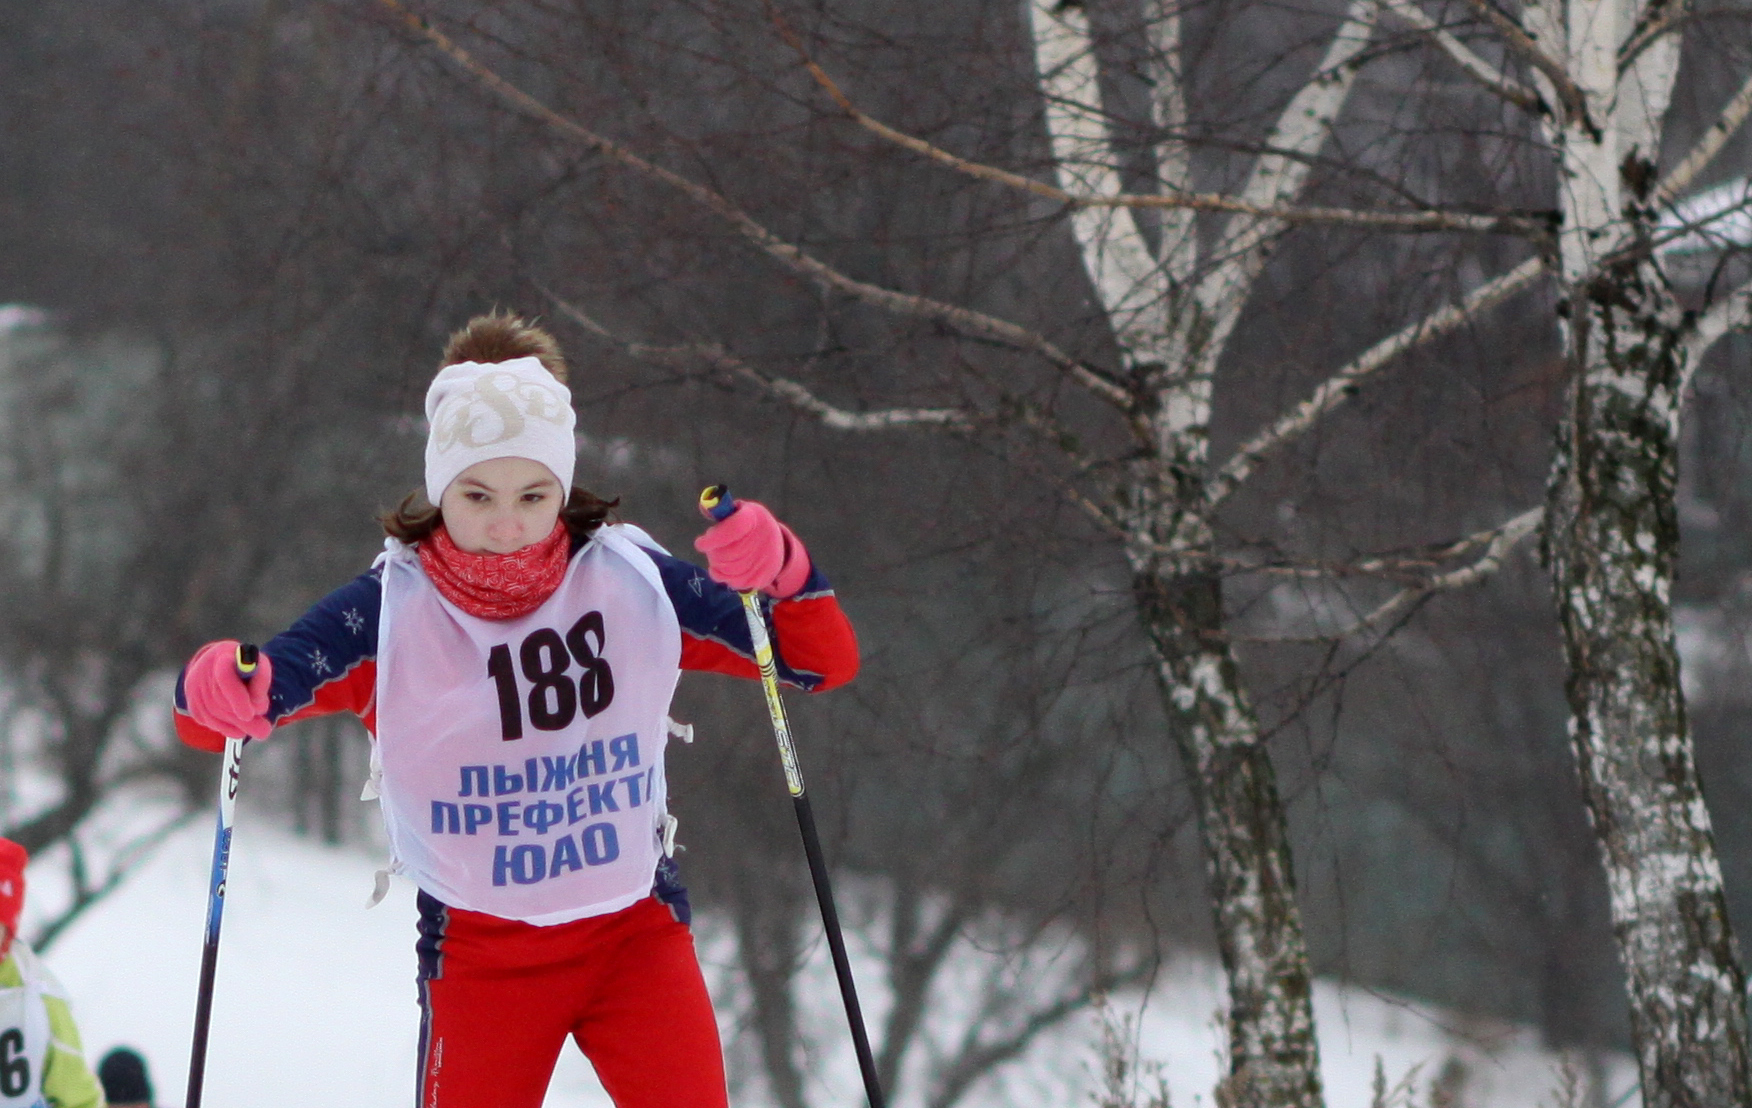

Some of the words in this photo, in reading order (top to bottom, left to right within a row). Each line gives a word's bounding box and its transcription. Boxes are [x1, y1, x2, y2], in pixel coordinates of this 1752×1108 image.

[487, 611, 615, 741] 188
[458, 733, 641, 797] ЛЫЖНЯ
[431, 764, 654, 836] ПРЕФЕКТ
[492, 822, 620, 887] ЮАО
